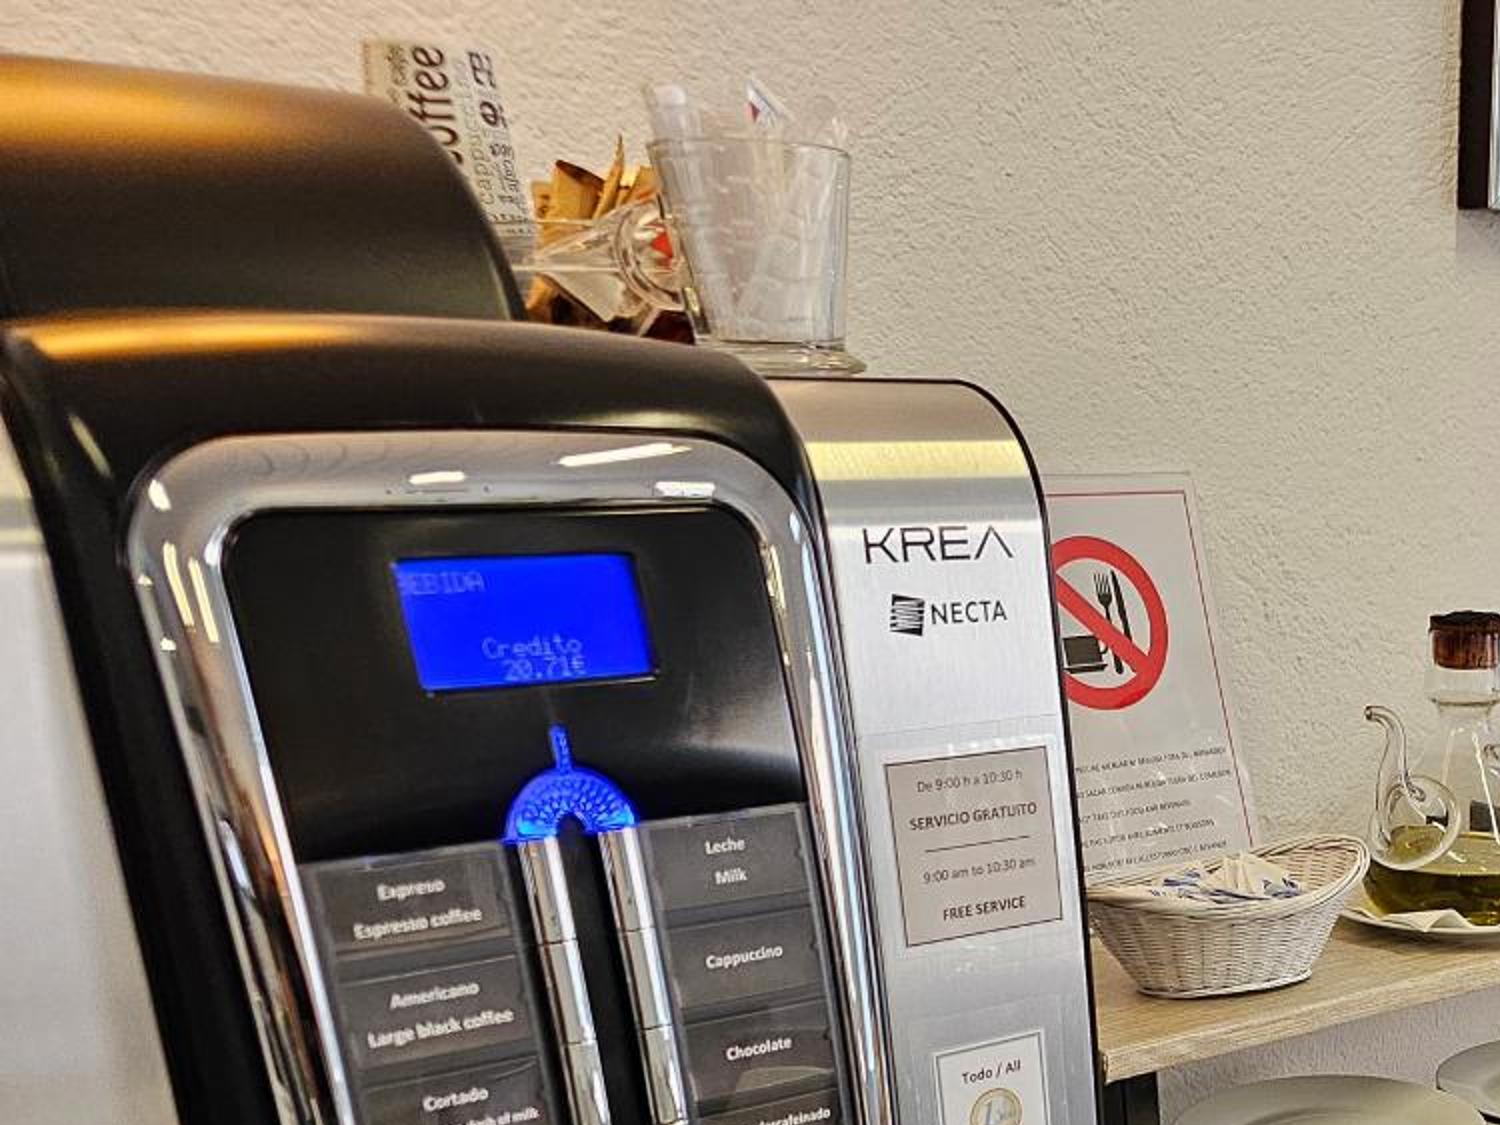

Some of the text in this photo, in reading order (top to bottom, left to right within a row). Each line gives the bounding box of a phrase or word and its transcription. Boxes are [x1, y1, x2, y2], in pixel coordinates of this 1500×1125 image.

[406, 46, 464, 165] offee
[861, 524, 1014, 564] KREA
[930, 600, 1008, 625] NECTA
[917, 781, 933, 794] De
[935, 776, 961, 791] 9:00
[982, 771, 1014, 785] 10:30
[909, 802, 1037, 831] SERVICIO GRATUITO
[705, 837, 746, 856] Leche
[714, 867, 748, 885] Milk
[923, 857, 1036, 884] 9:00 am to 10:30 am
[376, 878, 445, 901] Expreso
[943, 896, 1025, 921] FREE SERVICE
[353, 907, 482, 941] Espresso coffee
[705, 945, 783, 970] Cappuccino
[389, 981, 480, 1009] Americano
[367, 1009, 514, 1049] Large black coffee
[726, 1037, 793, 1062] Chocolate
[962, 1066, 993, 1085] Todo
[1005, 1059, 1021, 1076] All
[422, 1087, 490, 1112] Cortado
